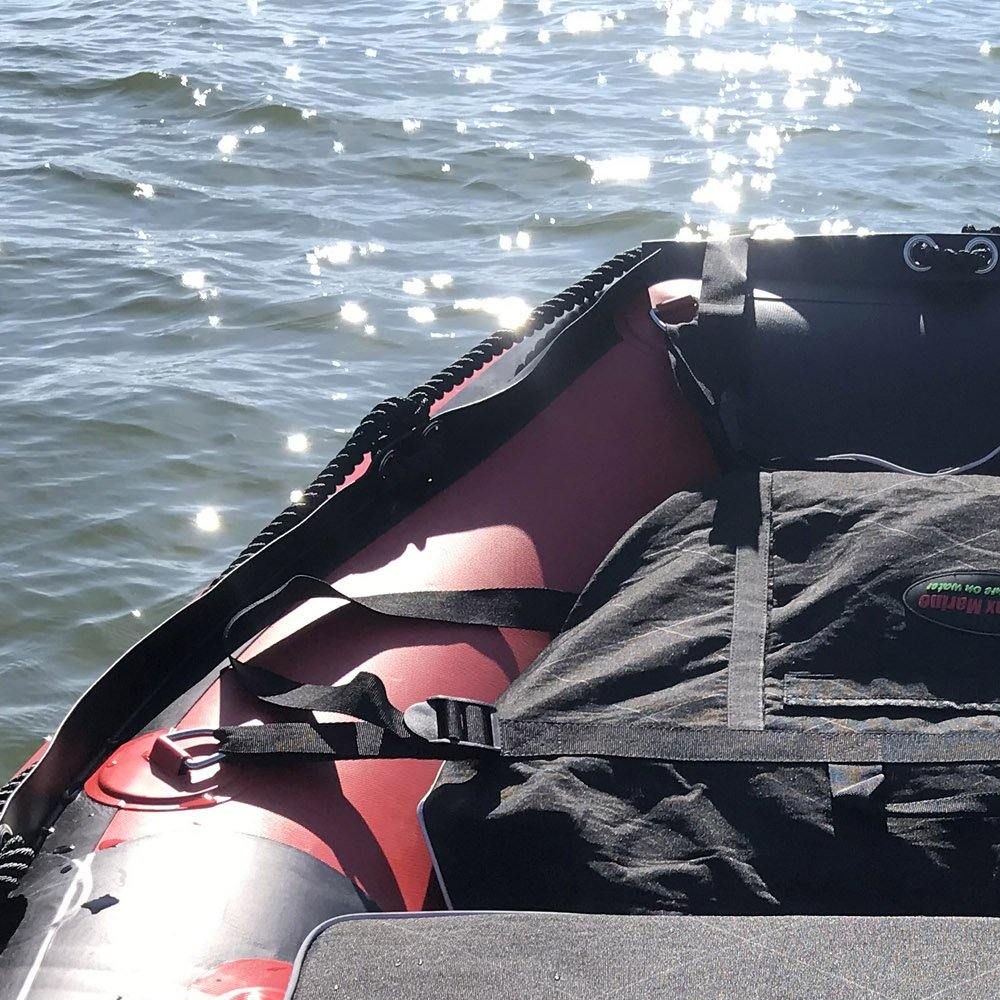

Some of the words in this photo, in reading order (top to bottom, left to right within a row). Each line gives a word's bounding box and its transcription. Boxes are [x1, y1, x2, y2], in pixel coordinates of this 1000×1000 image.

[926, 582, 962, 593] water
[965, 584, 981, 594] on
[918, 594, 983, 615] Marine
